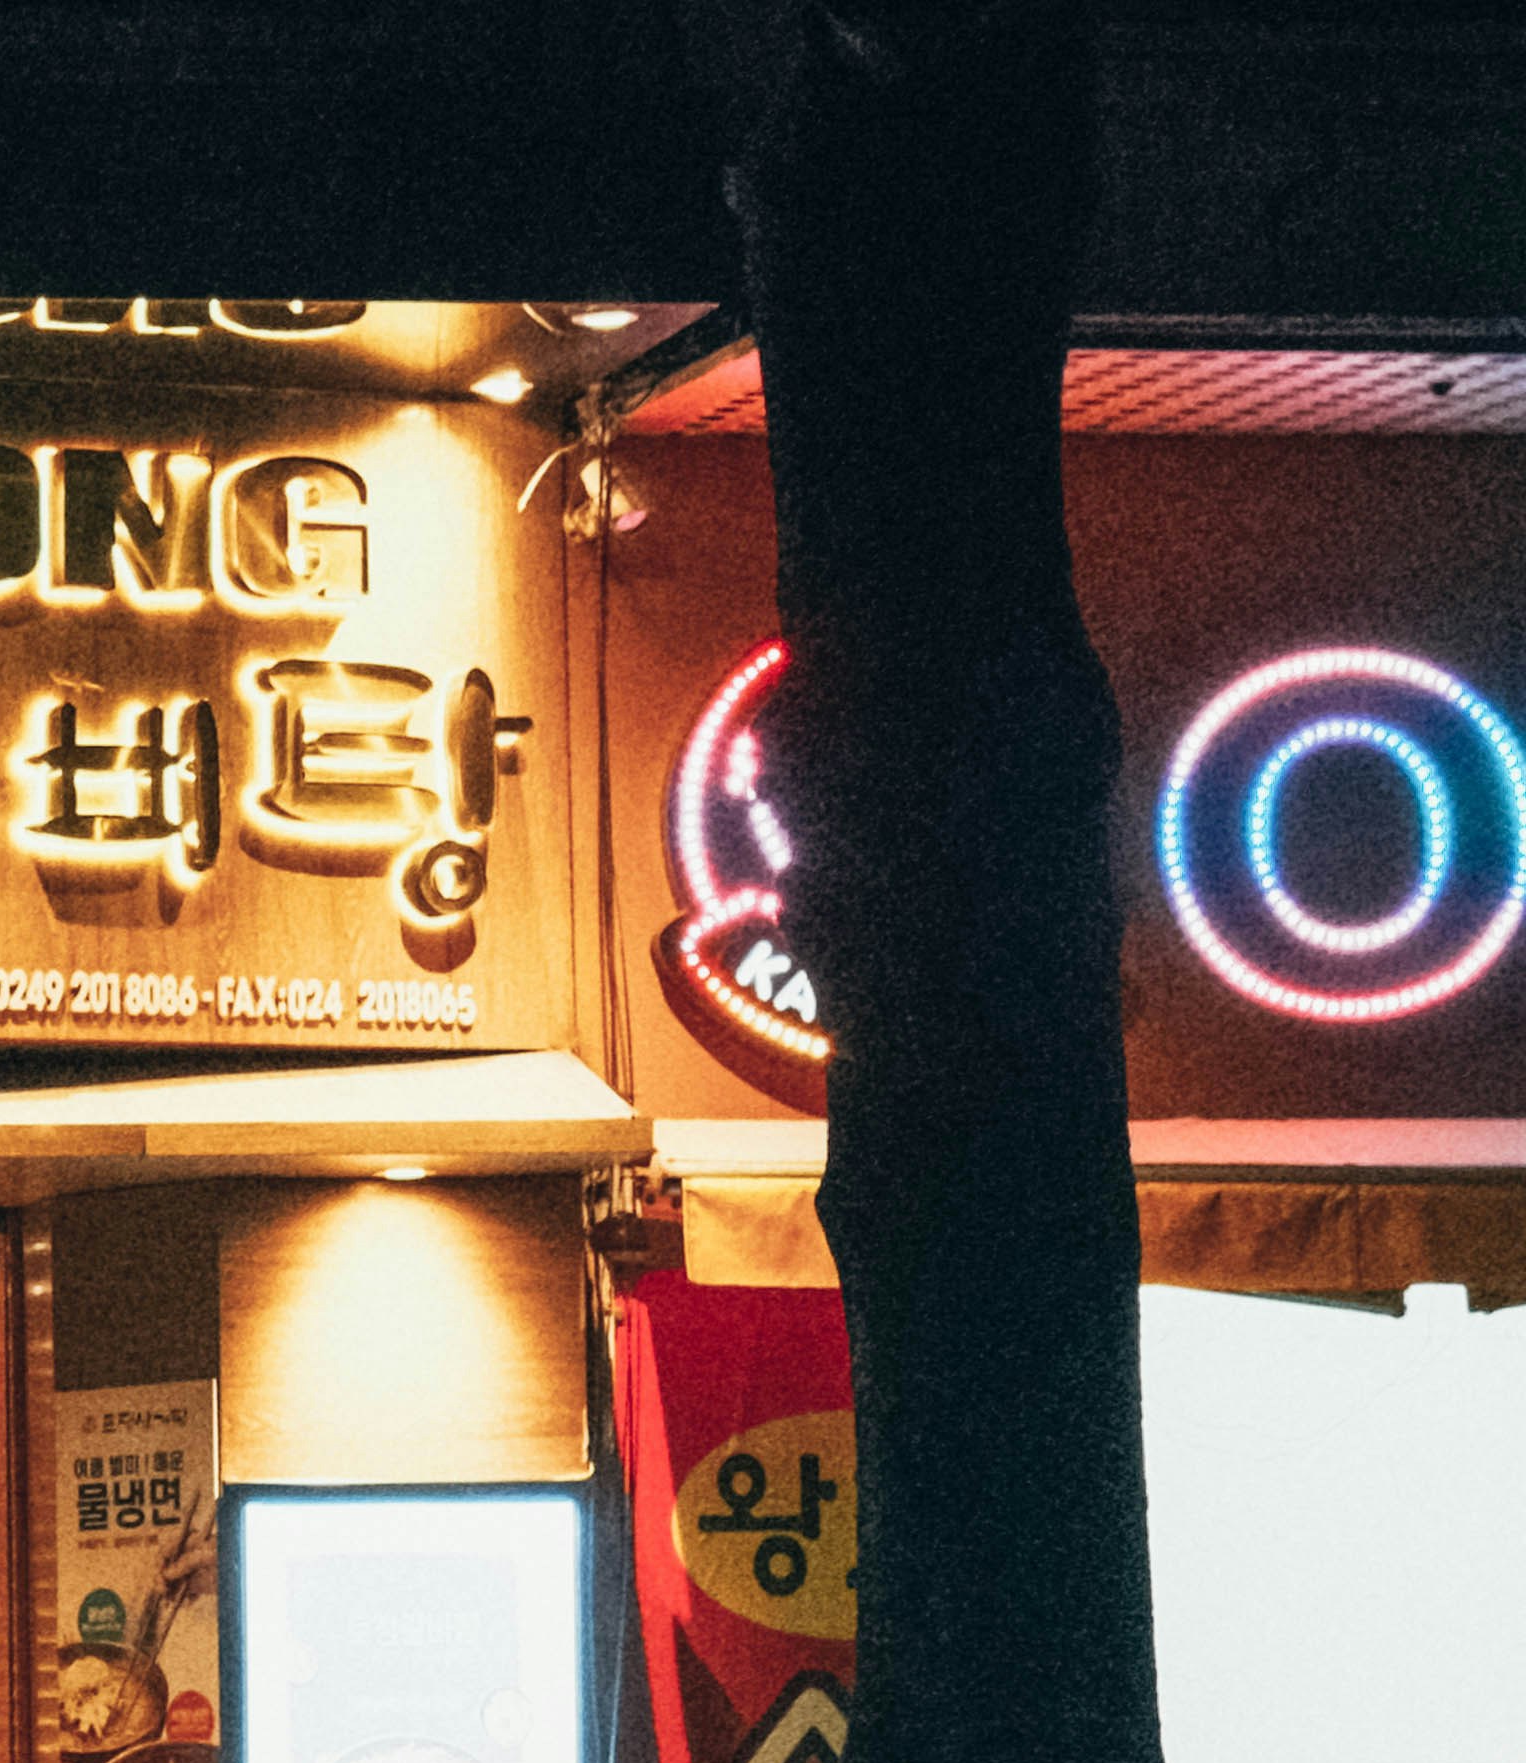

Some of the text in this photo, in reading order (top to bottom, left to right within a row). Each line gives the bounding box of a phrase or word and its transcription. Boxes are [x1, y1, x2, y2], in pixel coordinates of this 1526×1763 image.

[123, 974, 198, 1017] 8086
[357, 980, 477, 1026] 2018065
[78, 1477, 181, 1532] 물냉면
